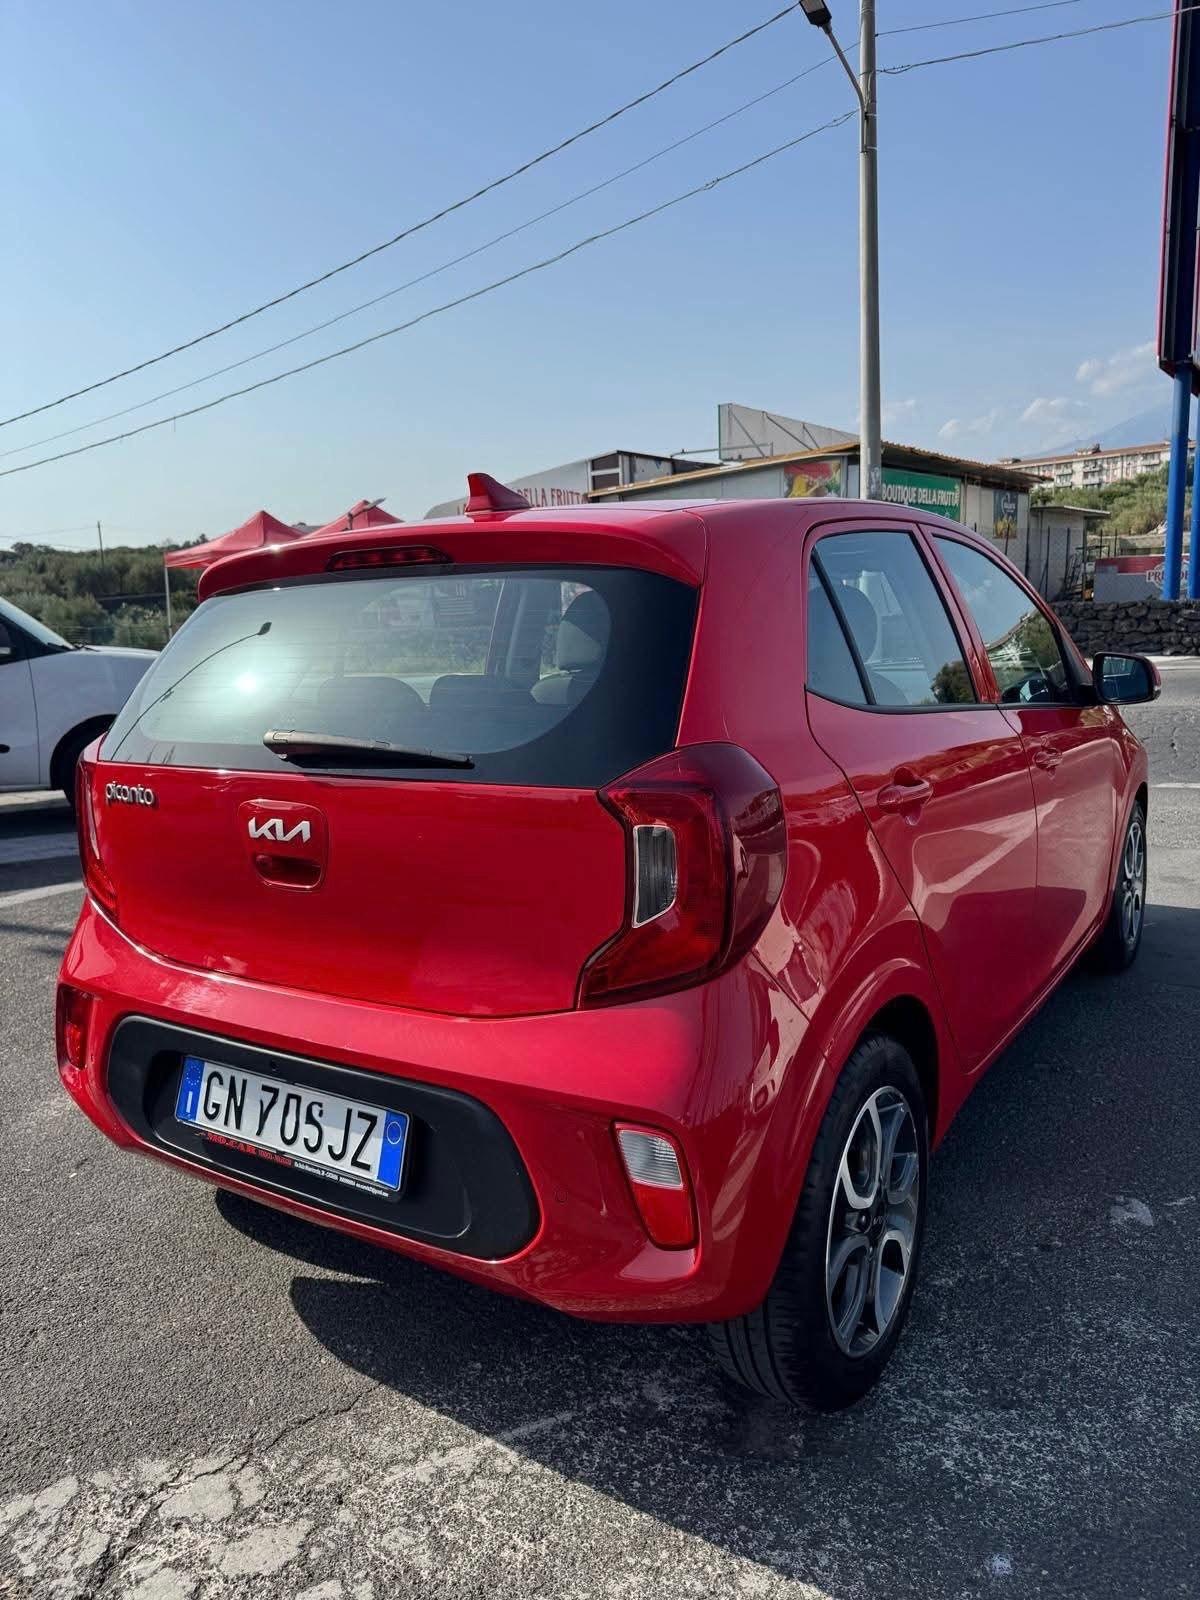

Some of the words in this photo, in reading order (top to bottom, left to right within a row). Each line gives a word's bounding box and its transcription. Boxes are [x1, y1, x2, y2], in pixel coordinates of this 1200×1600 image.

[881, 483, 917, 505] BOUTIQUE
[917, 487, 937, 504] DELLA
[105, 780, 154, 806] picanto
[248, 816, 311, 843] KIA
[203, 1071, 248, 1130] GN
